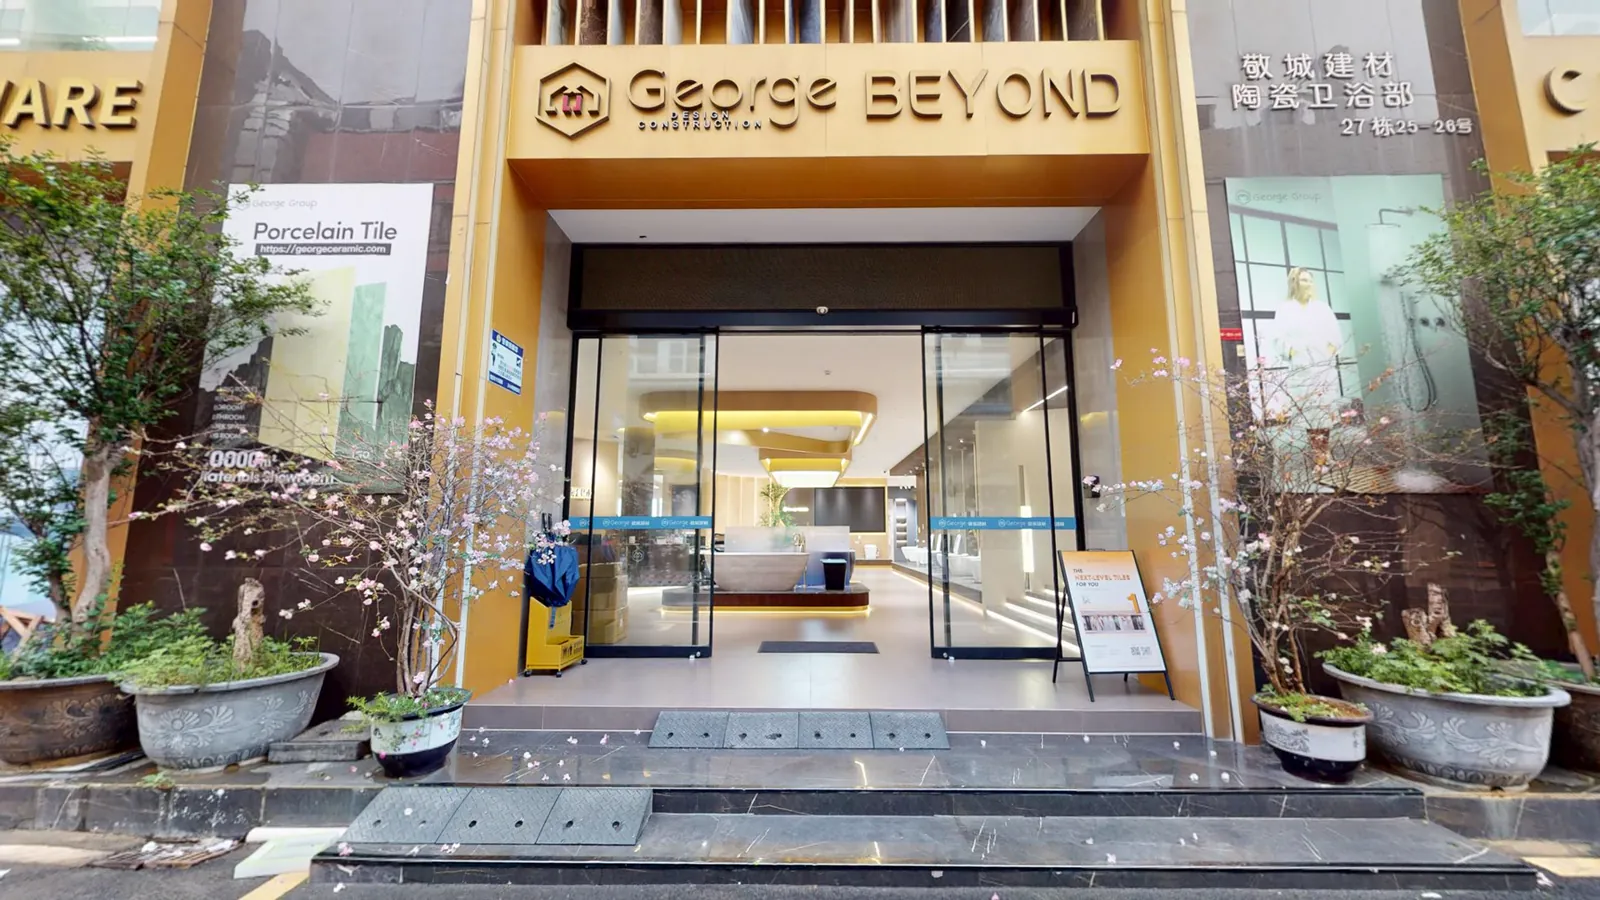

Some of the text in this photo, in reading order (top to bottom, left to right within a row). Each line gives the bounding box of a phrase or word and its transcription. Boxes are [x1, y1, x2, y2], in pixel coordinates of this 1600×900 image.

[1241, 51, 1395, 80] 敬城建材
[0, 78, 144, 130] ARE
[627, 67, 1121, 129] George BEYOND
[1232, 81, 1415, 111] 陶瓷卫浴部
[638, 119, 762, 131] CONSTRUCTION
[671, 110, 730, 121] DESIGN
[252, 199, 318, 209] George Group
[253, 221, 398, 241] Porcelain Tile
[260, 243, 386, 255] https://georgeceramic.com
